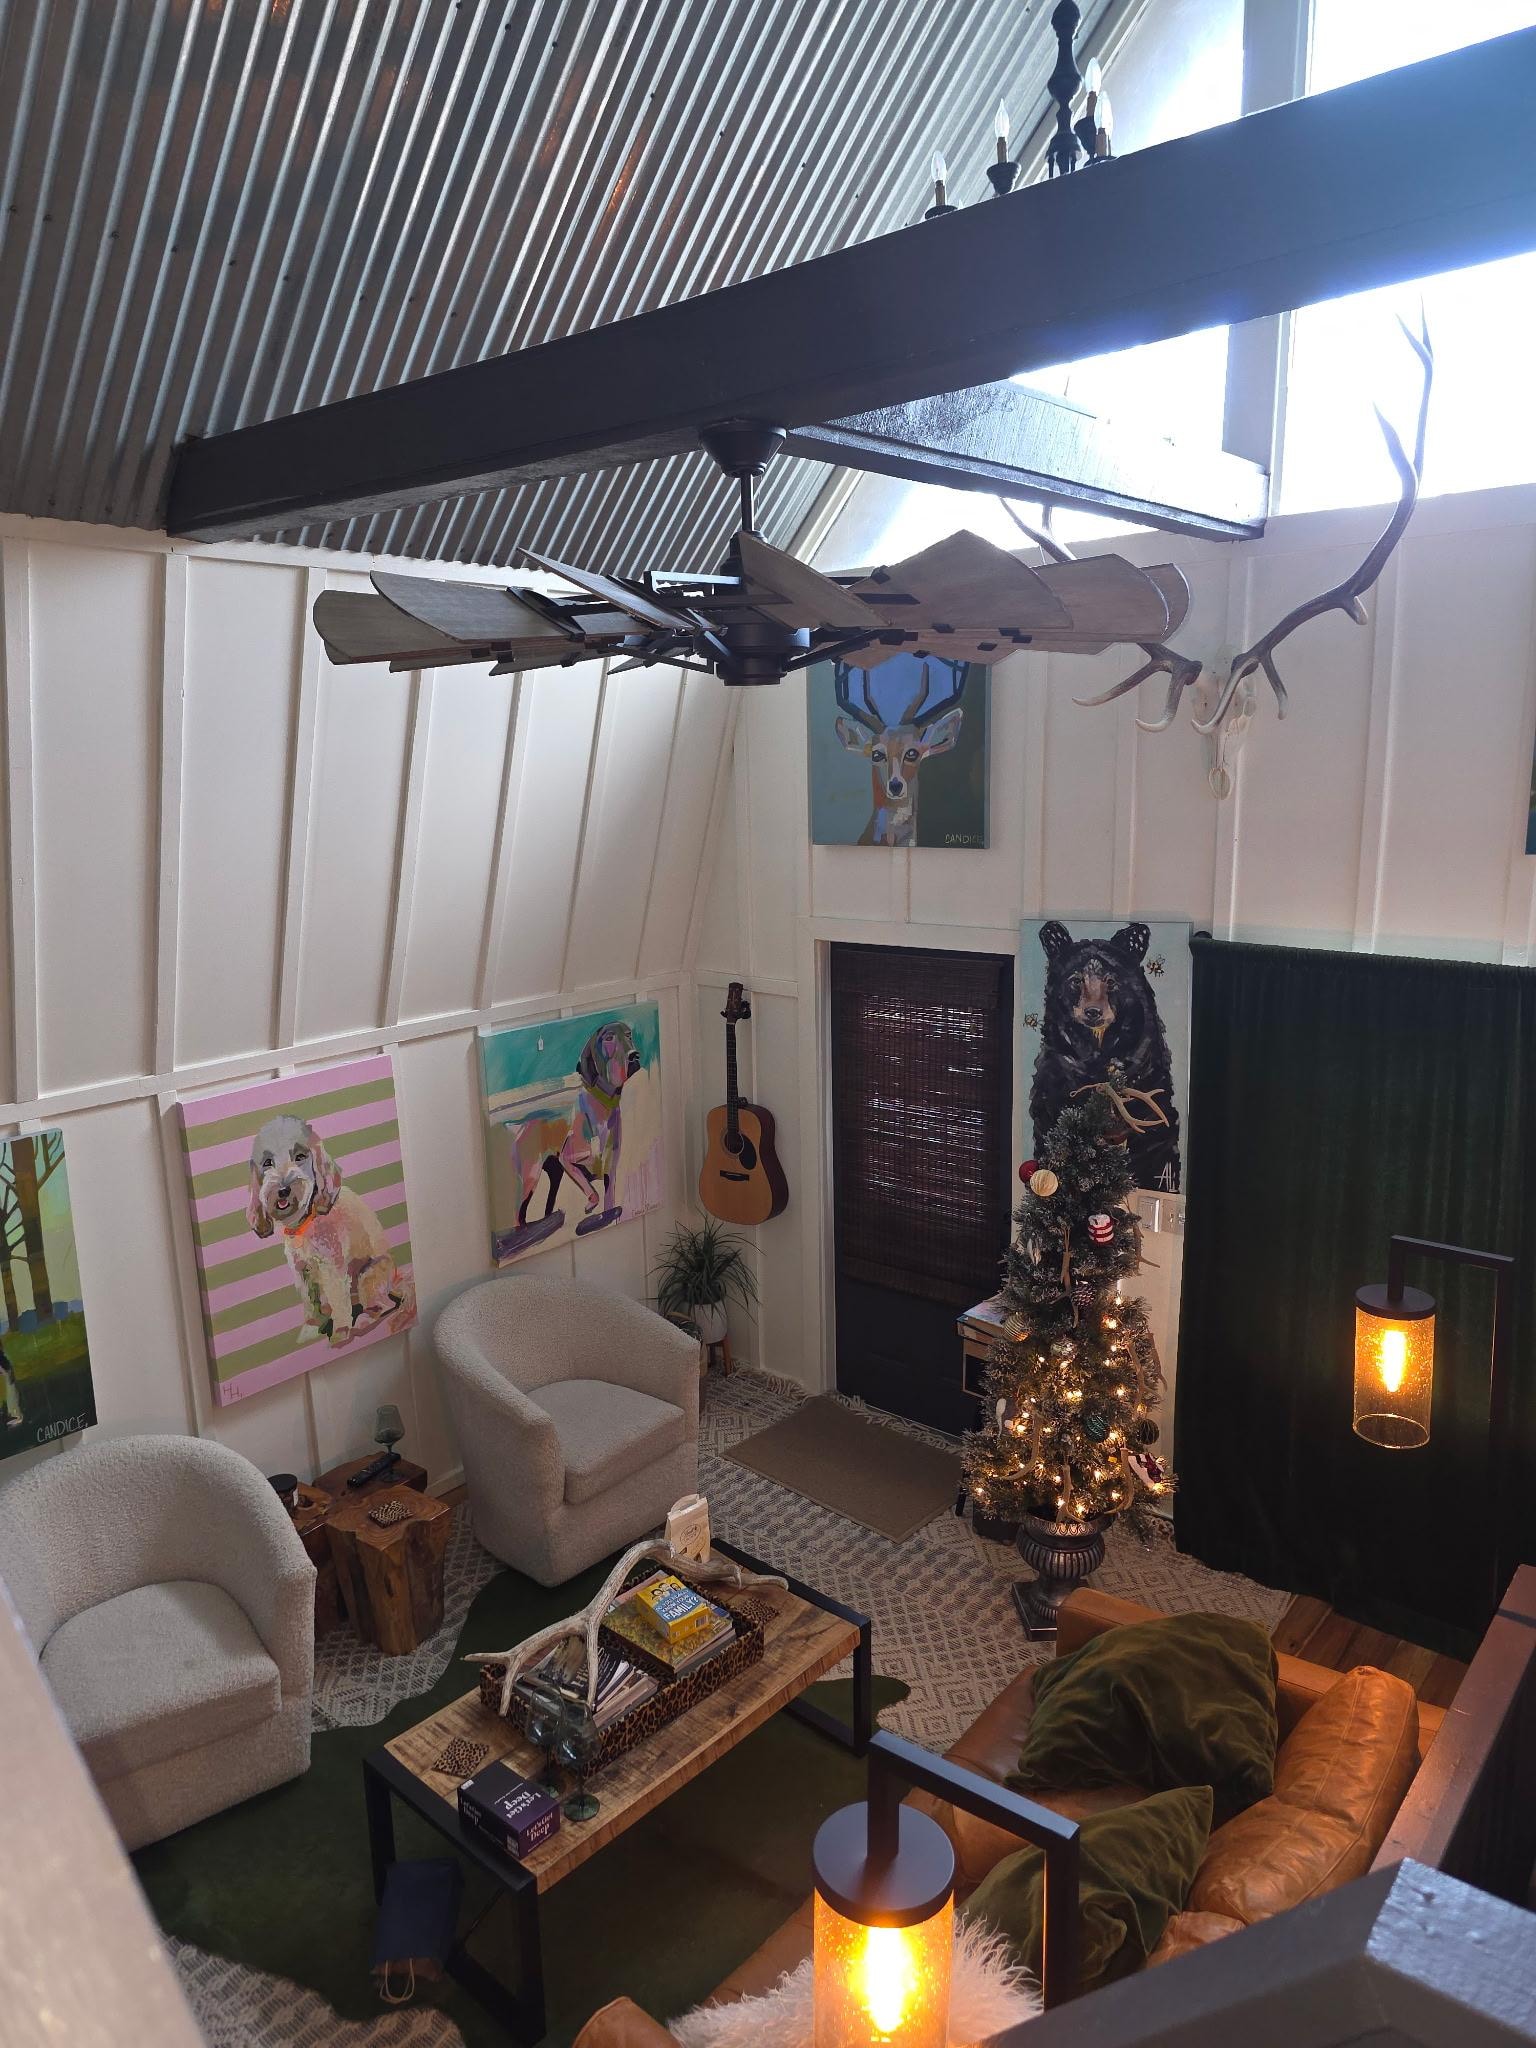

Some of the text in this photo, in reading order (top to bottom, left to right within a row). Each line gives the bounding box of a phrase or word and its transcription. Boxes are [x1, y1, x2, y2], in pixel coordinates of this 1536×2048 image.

[662, 1596, 699, 1620] FAMILY?
[503, 1790, 531, 1810] Deep
[505, 1805, 523, 1818] Get
[530, 1823, 550, 1841] Deep
